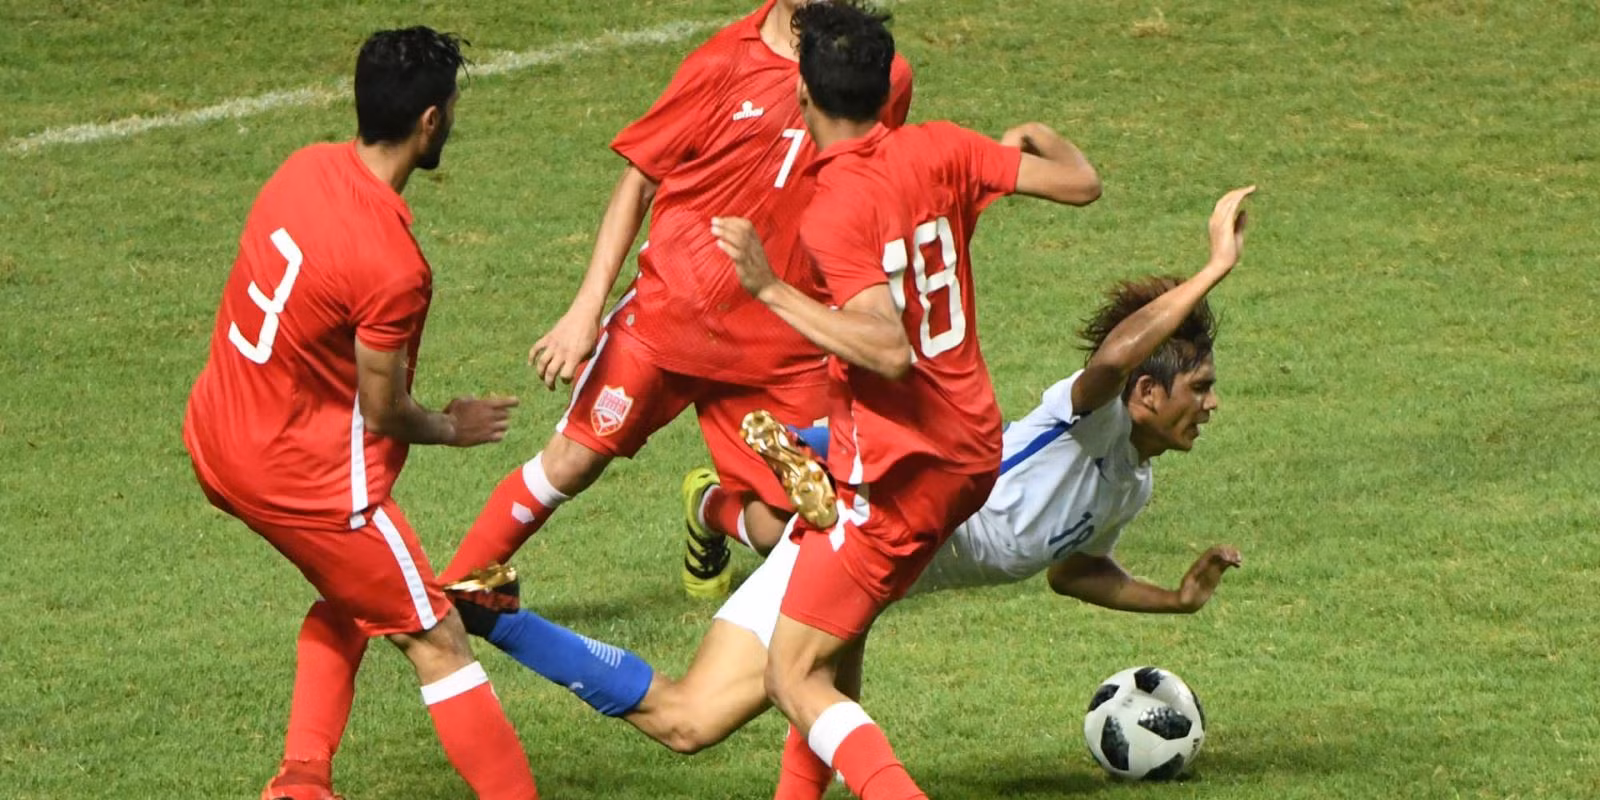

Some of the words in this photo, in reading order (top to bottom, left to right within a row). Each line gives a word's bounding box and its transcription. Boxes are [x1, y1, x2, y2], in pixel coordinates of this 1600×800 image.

[228, 227, 303, 365] 3
[882, 216, 966, 363] 18
[1048, 511, 1095, 560] 18
